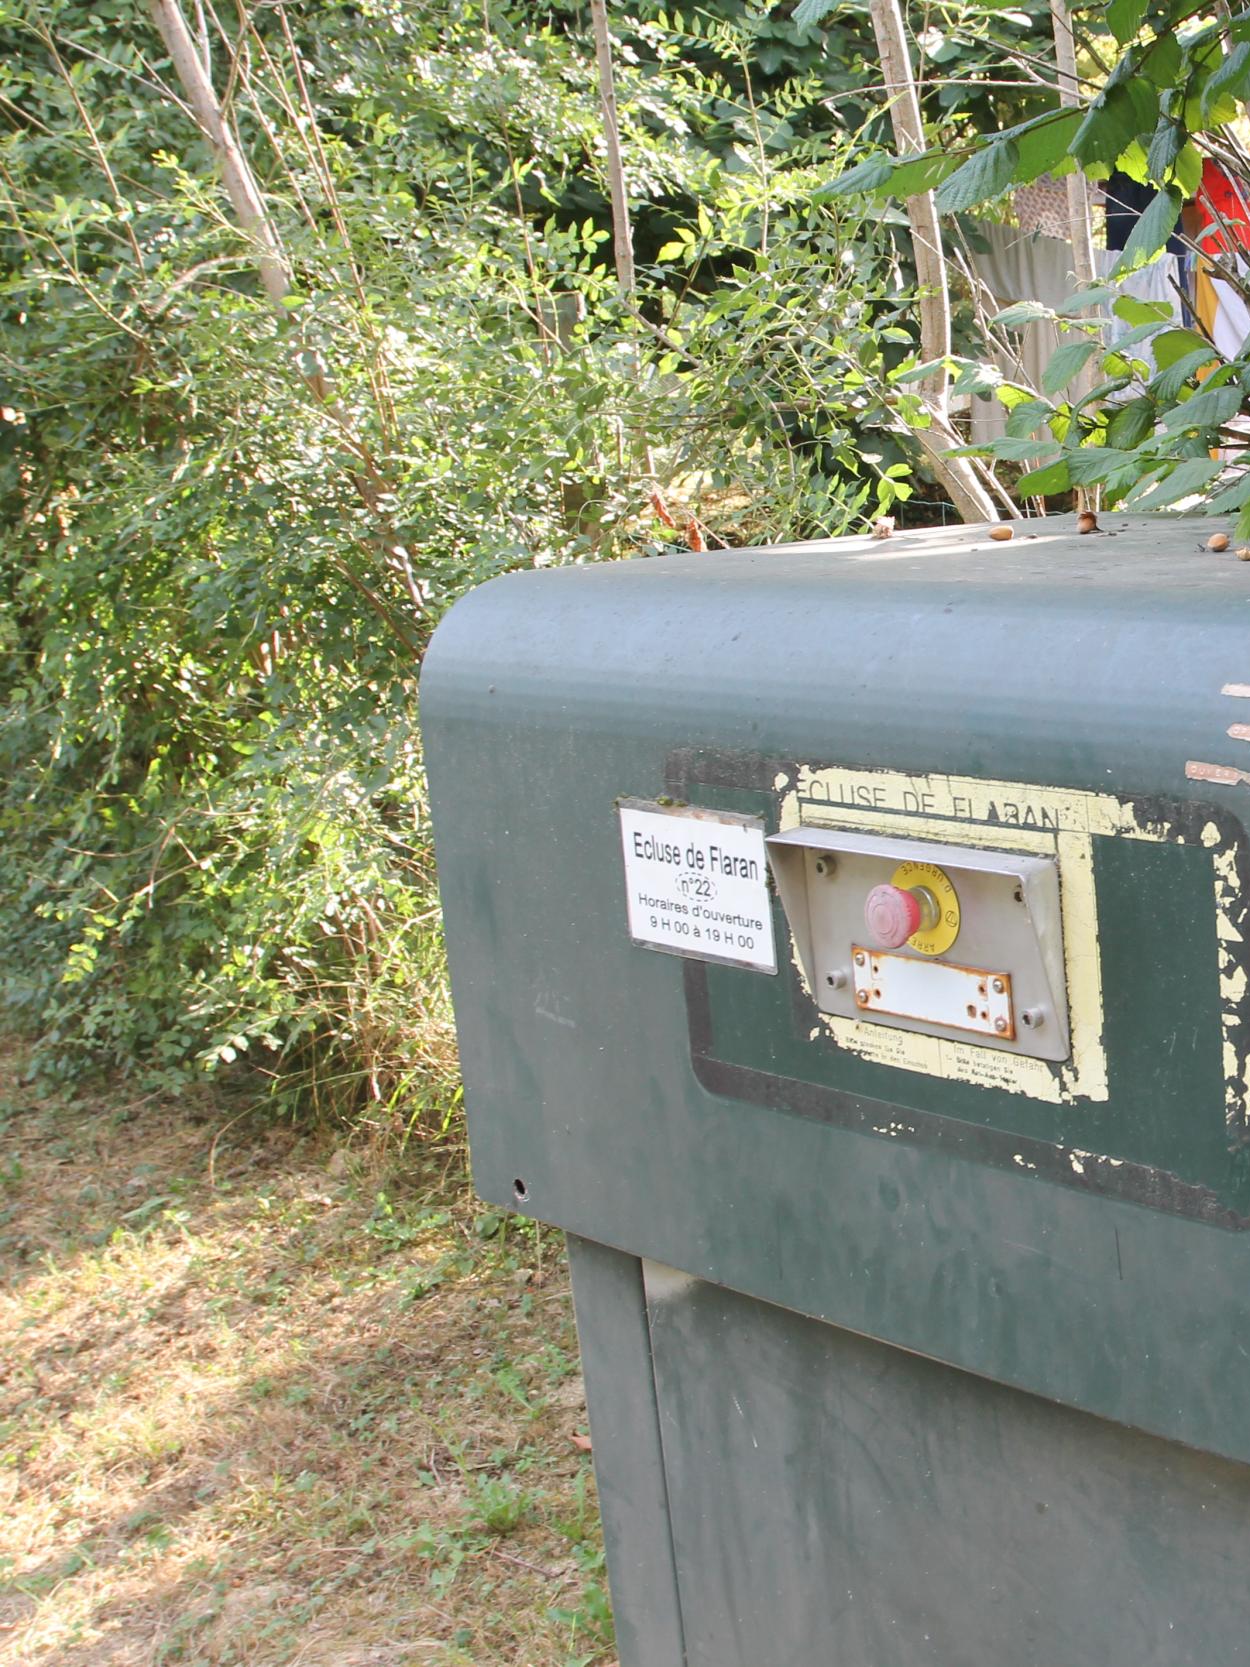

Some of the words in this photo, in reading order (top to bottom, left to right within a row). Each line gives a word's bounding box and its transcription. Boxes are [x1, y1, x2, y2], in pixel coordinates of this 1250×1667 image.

[633, 831, 681, 866] Ecluse
[686, 842, 705, 870] de
[709, 846, 759, 880] Flaran
[681, 877, 711, 897] n°22
[638, 893, 689, 915] Horaires
[692, 905, 763, 930] d'ouverture
[650, 916, 658, 927] 9
[661, 918, 671, 931] H
[675, 921, 690, 935] 00
[693, 926, 701, 938] à
[706, 928, 720, 942] 19
[724, 932, 734, 945] H
[738, 935, 754, 949] 00
